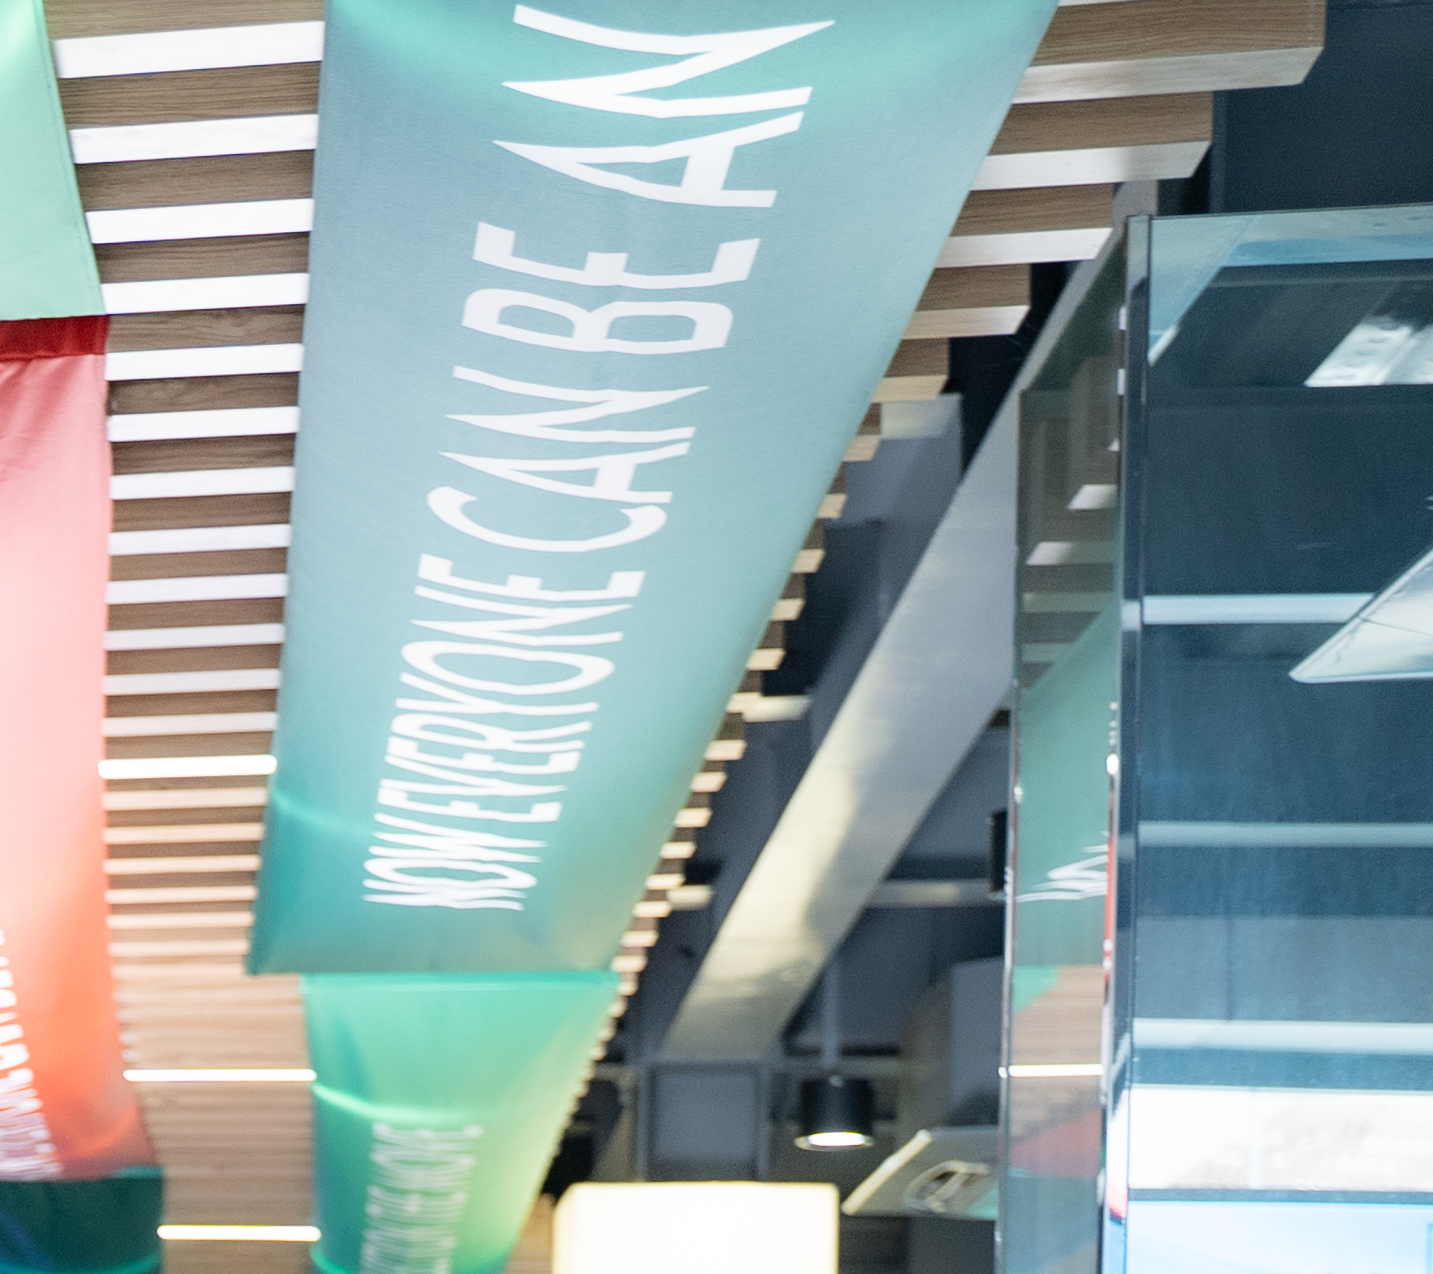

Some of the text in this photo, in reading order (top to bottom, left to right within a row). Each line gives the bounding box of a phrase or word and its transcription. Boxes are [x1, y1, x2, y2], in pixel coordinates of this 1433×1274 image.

[492, 5, 836, 208] AN
[461, 220, 762, 355] BE
[426, 366, 709, 552] CAN
[375, 555, 646, 822] EVERYONE
[363, 805, 544, 912] NOW
